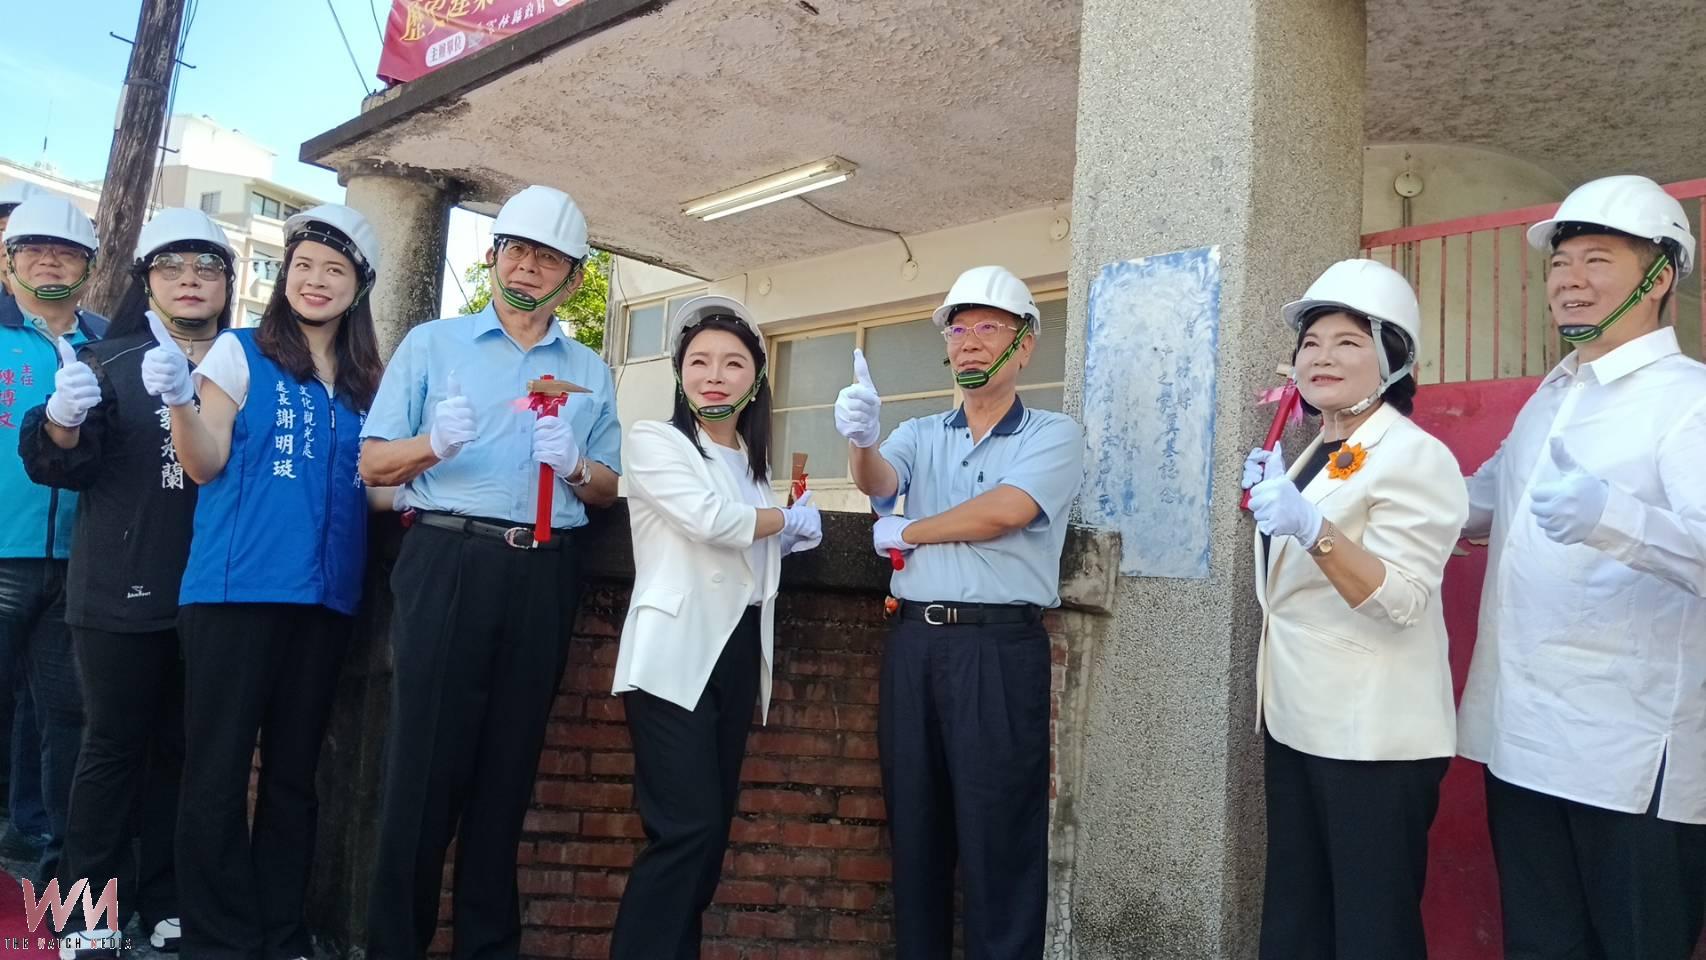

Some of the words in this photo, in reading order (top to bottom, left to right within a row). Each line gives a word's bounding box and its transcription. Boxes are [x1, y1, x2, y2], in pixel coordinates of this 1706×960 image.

[21, 364, 33, 387] 主任
[298, 384, 317, 460] 文化觀光處
